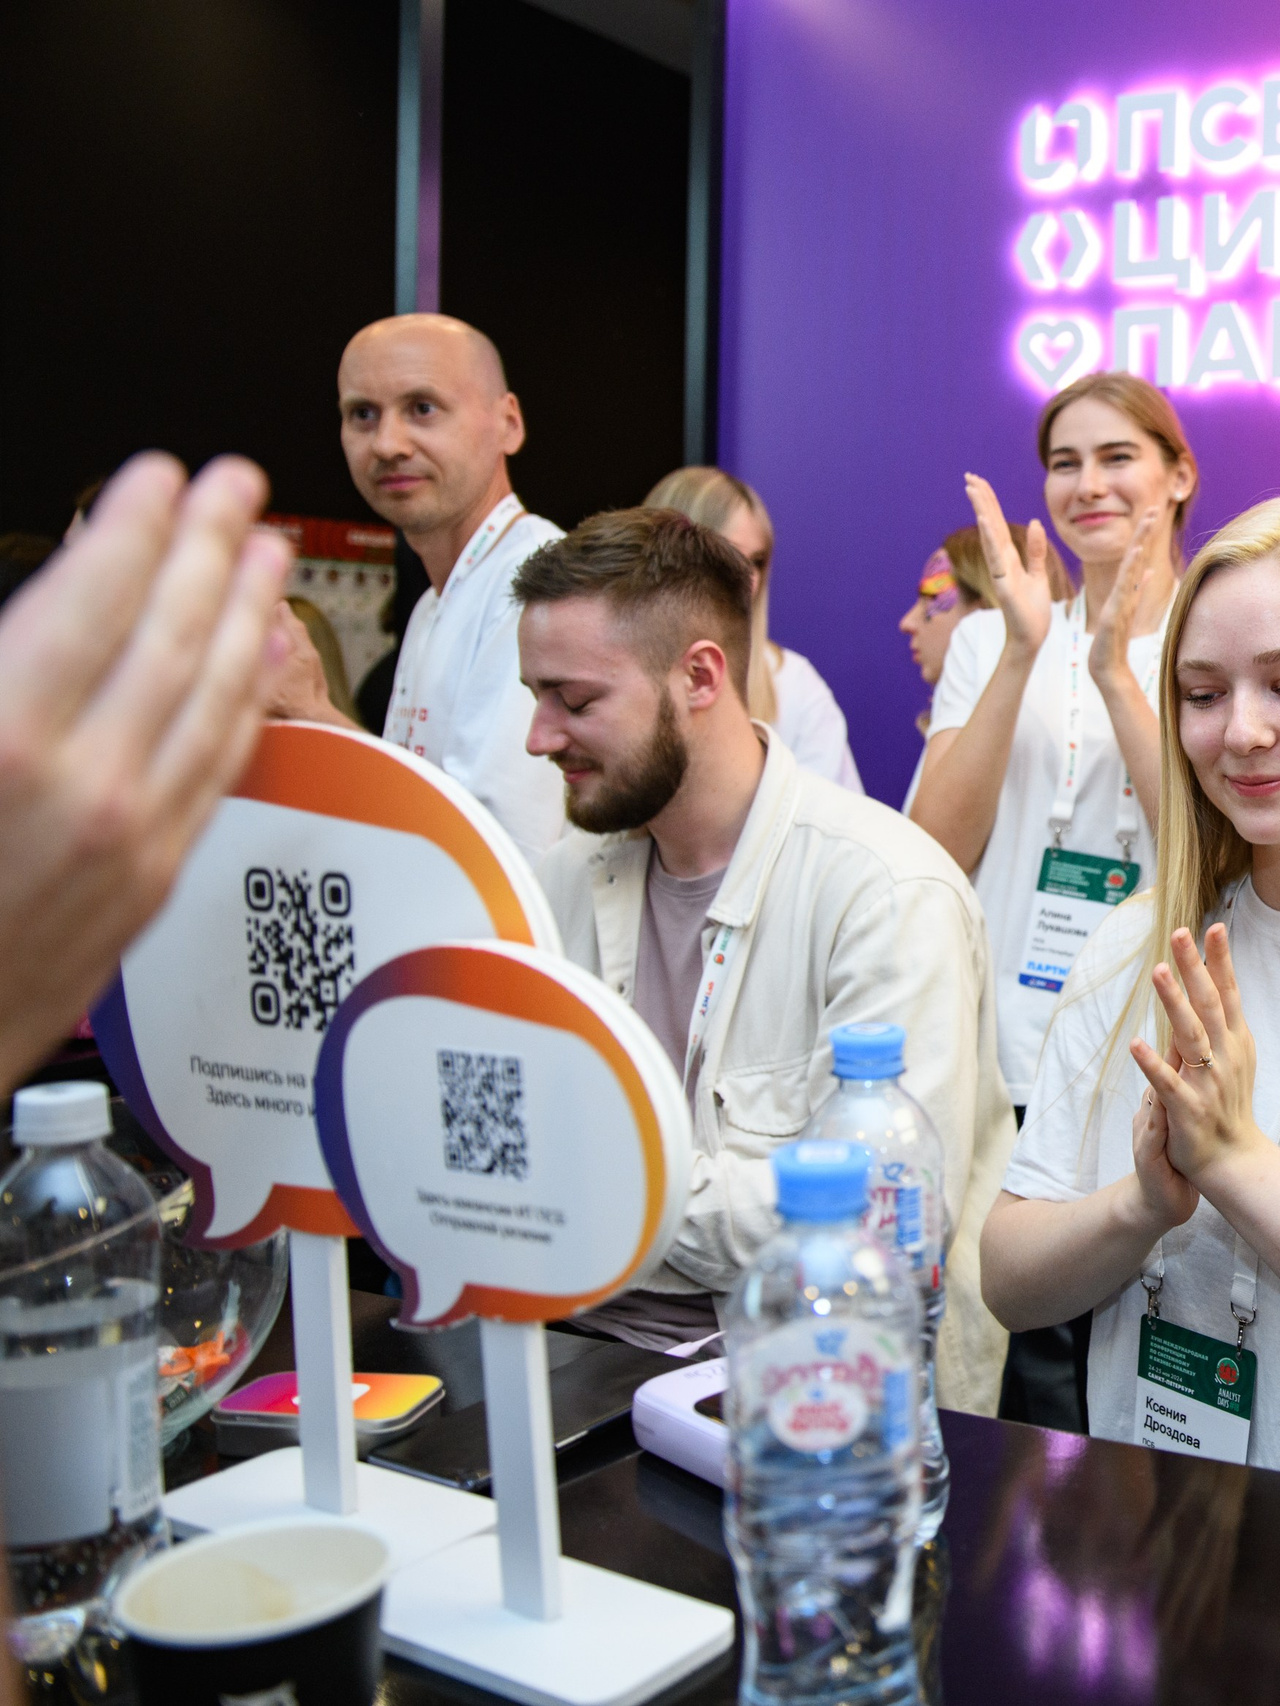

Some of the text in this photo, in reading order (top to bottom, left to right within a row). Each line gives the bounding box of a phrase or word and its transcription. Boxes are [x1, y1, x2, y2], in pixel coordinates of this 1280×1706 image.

[1027, 961, 1071, 977] ПАРТН
[189, 1054, 306, 1090] Подпишись на
[206, 1083, 252, 1109] Здесь
[254, 1096, 304, 1117] много
[1163, 1339, 1209, 1361] МЕЖДУНАРОДНАЯ
[1153, 1356, 1196, 1377] БИЗНЕС-АНАЛИЗУ
[1147, 1371, 1195, 1395] САНКТ-ПЕТЕРБУРГ
[1170, 1373, 1183, 1383] 2024
[1217, 1396, 1230, 1409] DAYS
[1218, 1388, 1241, 1404] ANALYST
[1145, 1395, 1187, 1425] Ксения
[1143, 1414, 1201, 1450] Дроздова
[1142, 1437, 1156, 1449] ПСБ
